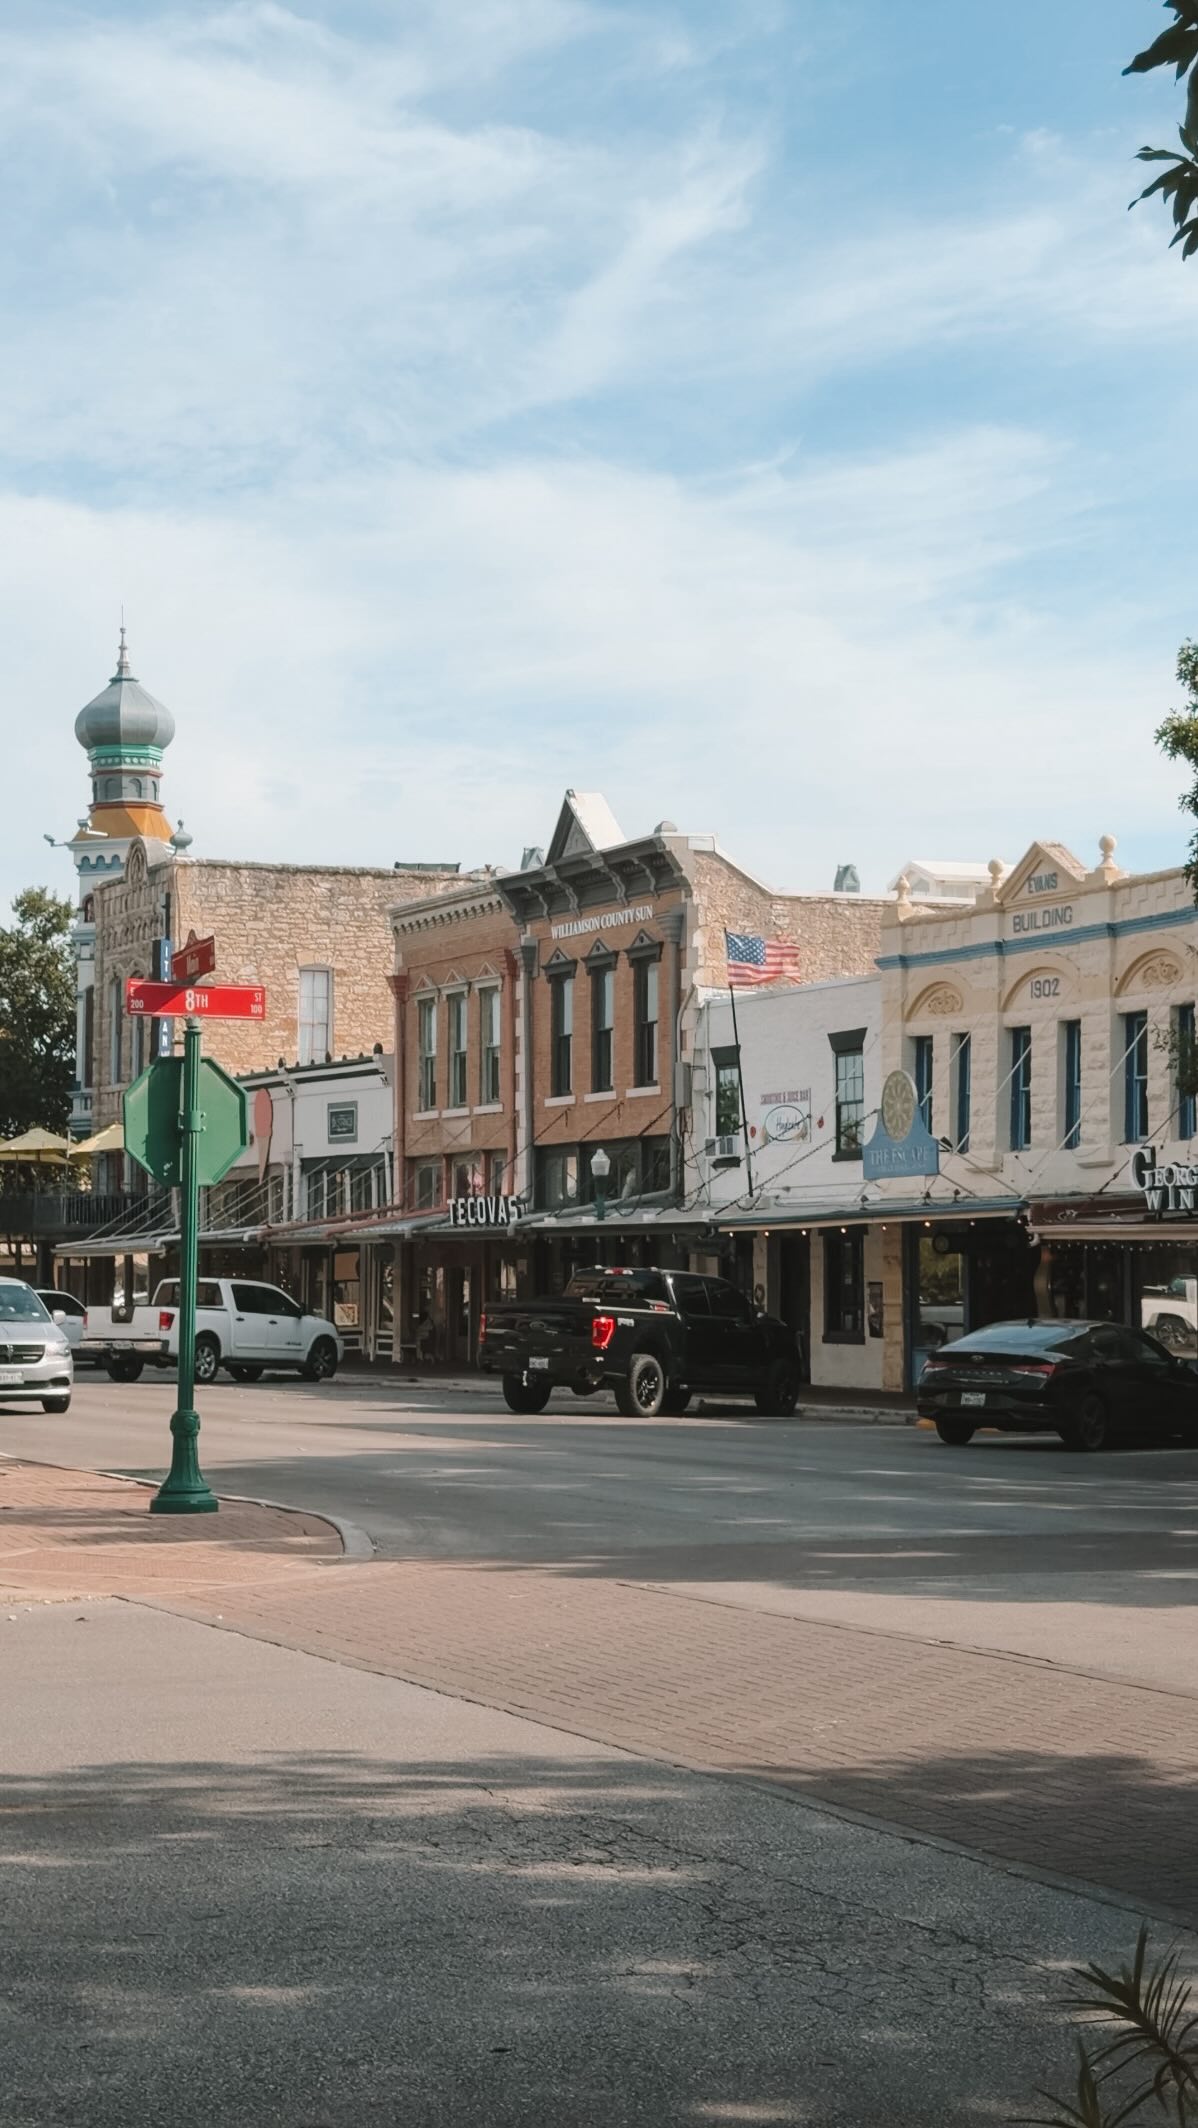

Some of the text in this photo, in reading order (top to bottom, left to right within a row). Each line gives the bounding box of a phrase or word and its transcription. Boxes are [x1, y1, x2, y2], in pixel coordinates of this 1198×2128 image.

[1027, 872, 1058, 893] EVANS
[551, 905, 653, 940] WILLIAMSON COUNTY SUN
[1013, 905, 1073, 933] BUILDING
[1030, 978, 1060, 999] 1902
[130, 1000, 144, 1009] 200
[185, 990, 209, 1011] 8TH
[254, 992, 262, 1003] ST
[250, 1004, 262, 1014] 100
[447, 1195, 518, 1225] TECOVAS
